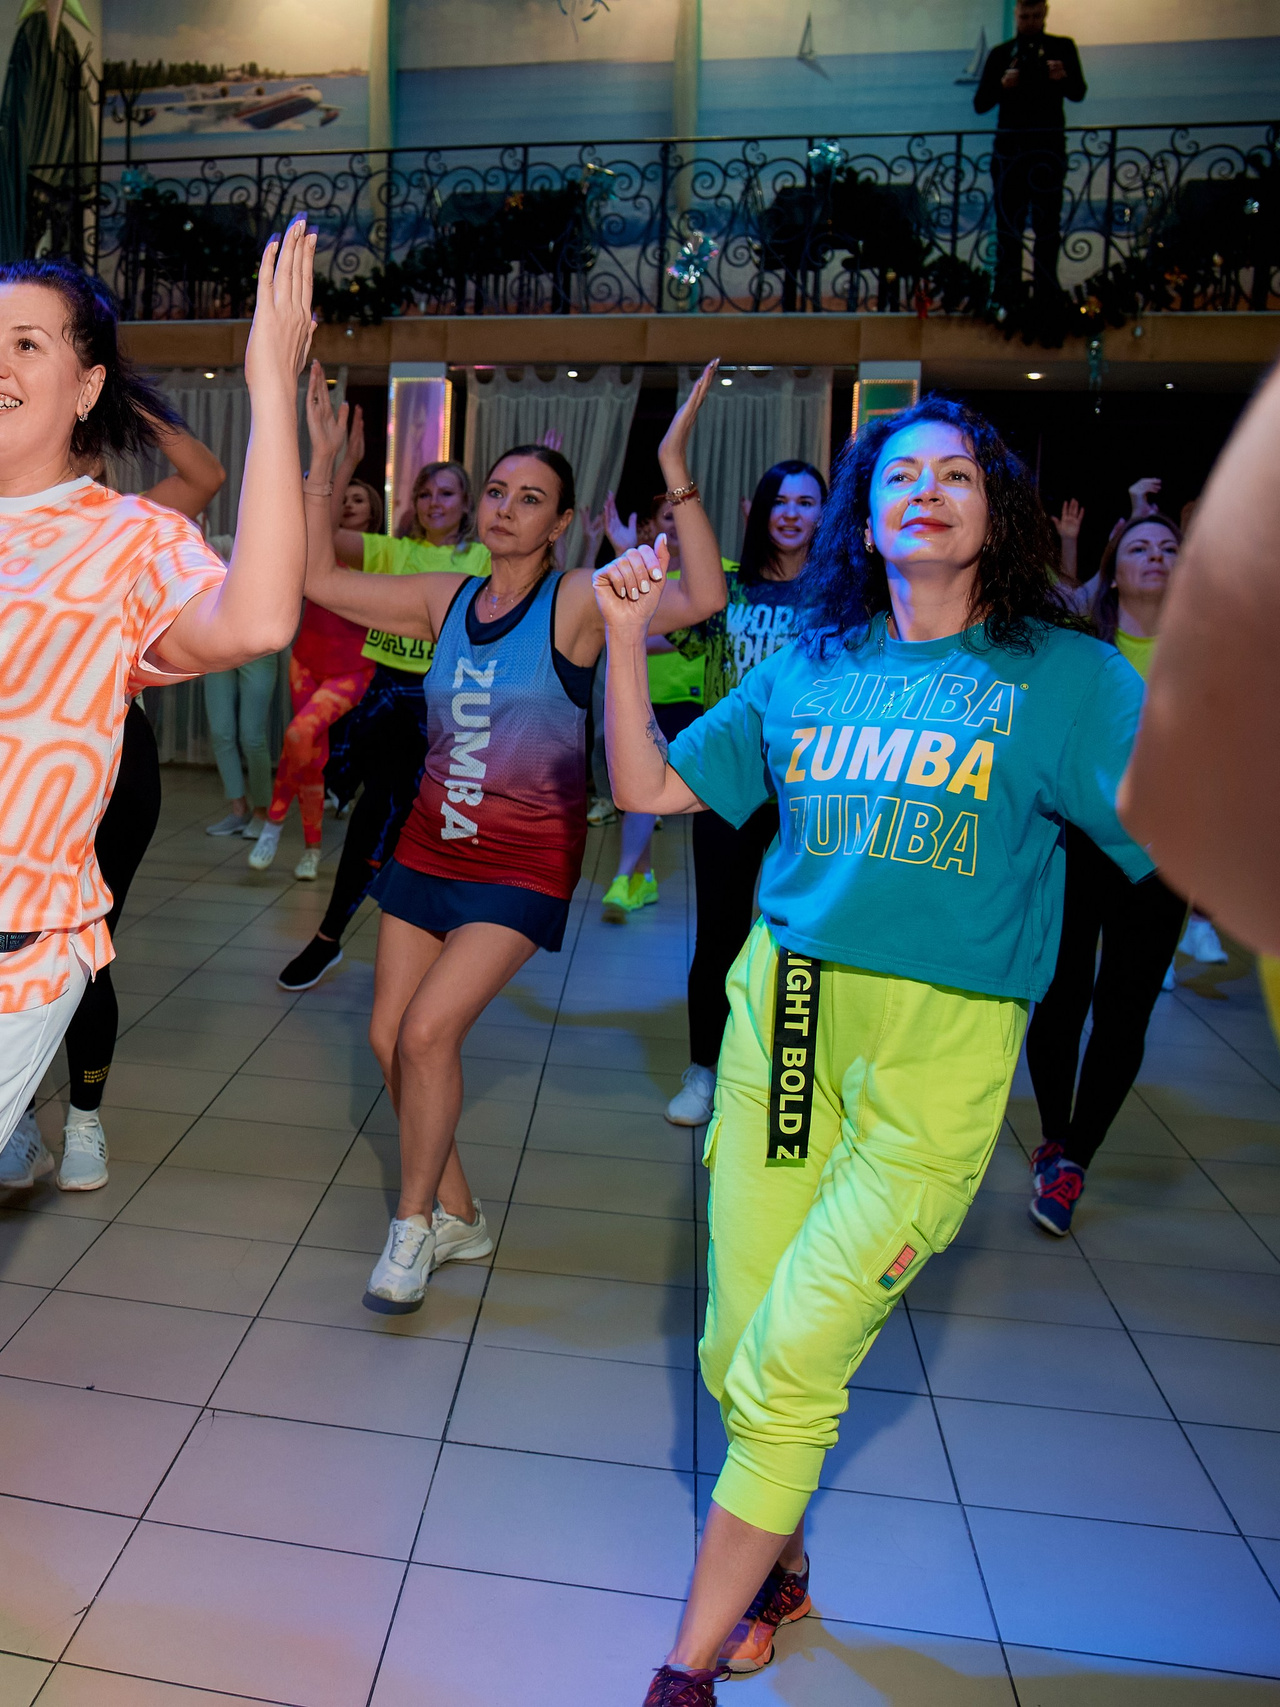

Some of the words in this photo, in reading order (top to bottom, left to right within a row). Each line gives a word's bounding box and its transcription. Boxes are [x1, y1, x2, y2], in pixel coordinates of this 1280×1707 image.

[726, 602, 797, 635] WOR
[791, 672, 1015, 736] ZUMBA
[440, 656, 498, 841] ZUMBA
[784, 725, 995, 801] ZUMBA
[789, 794, 979, 877] ZUMBA
[783, 951, 813, 1037] IGHT
[778, 1047, 808, 1135] BOLD
